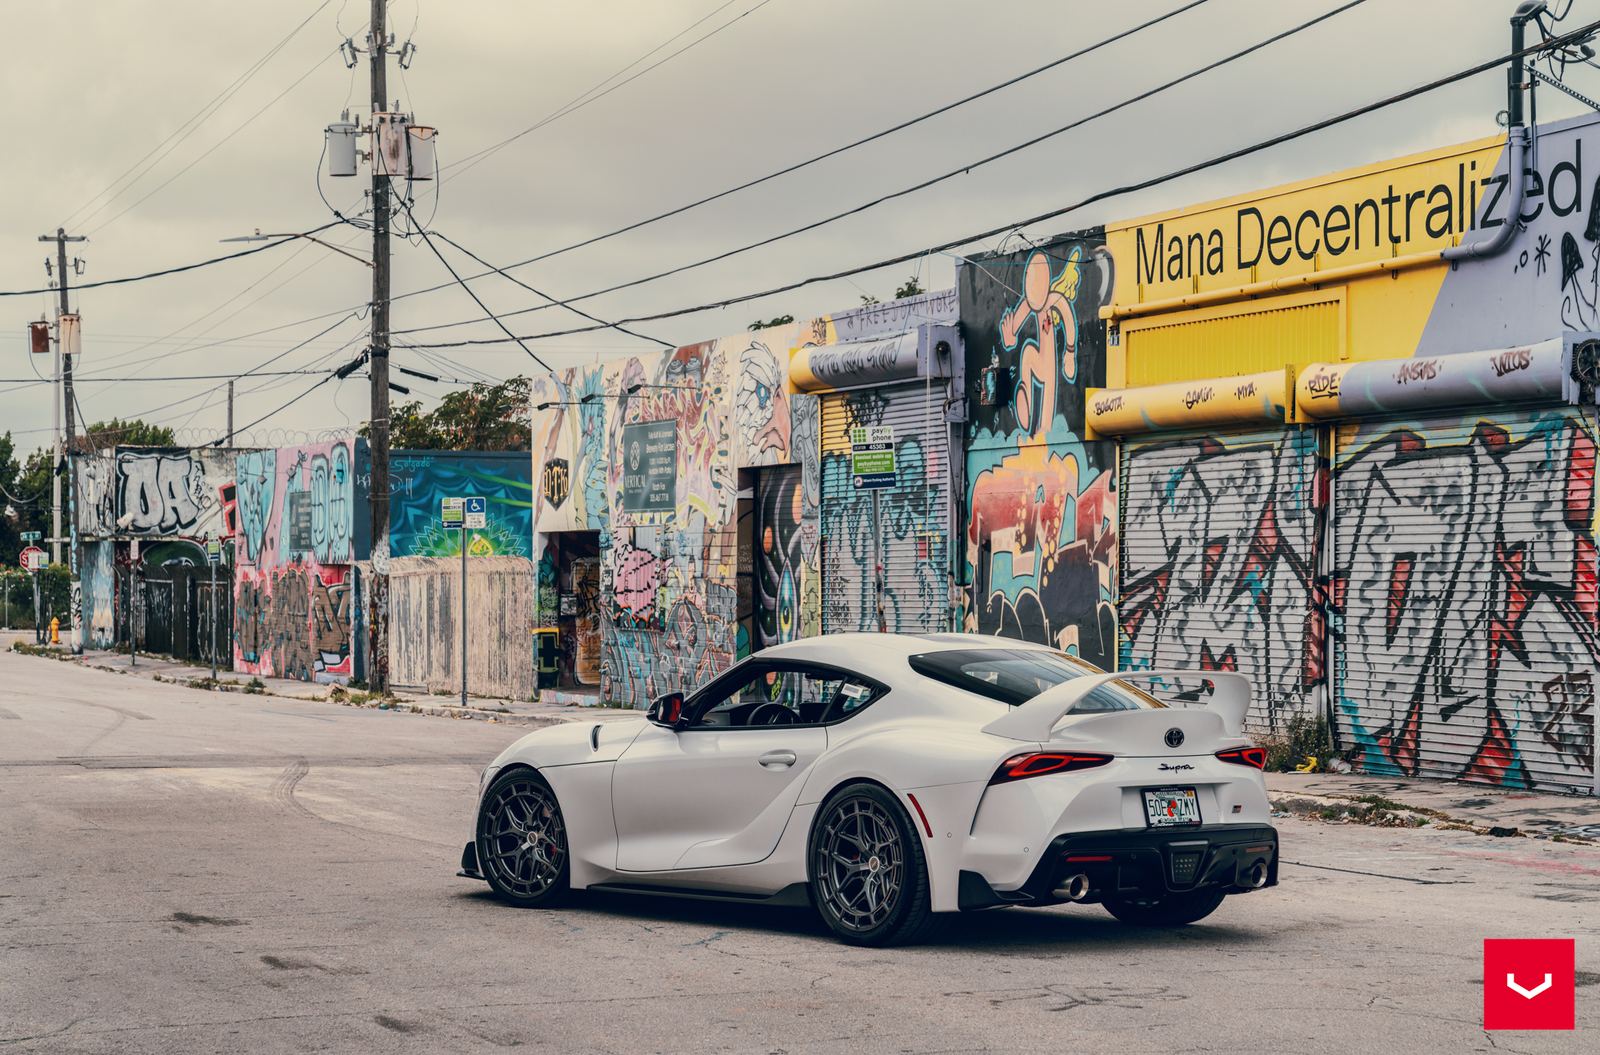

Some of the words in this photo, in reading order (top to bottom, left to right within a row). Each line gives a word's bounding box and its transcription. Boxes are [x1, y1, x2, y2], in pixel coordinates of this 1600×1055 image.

[1136, 223, 1224, 285] Mana
[1237, 138, 1582, 270] Decentralized
[1157, 763, 1195, 774] Supra
